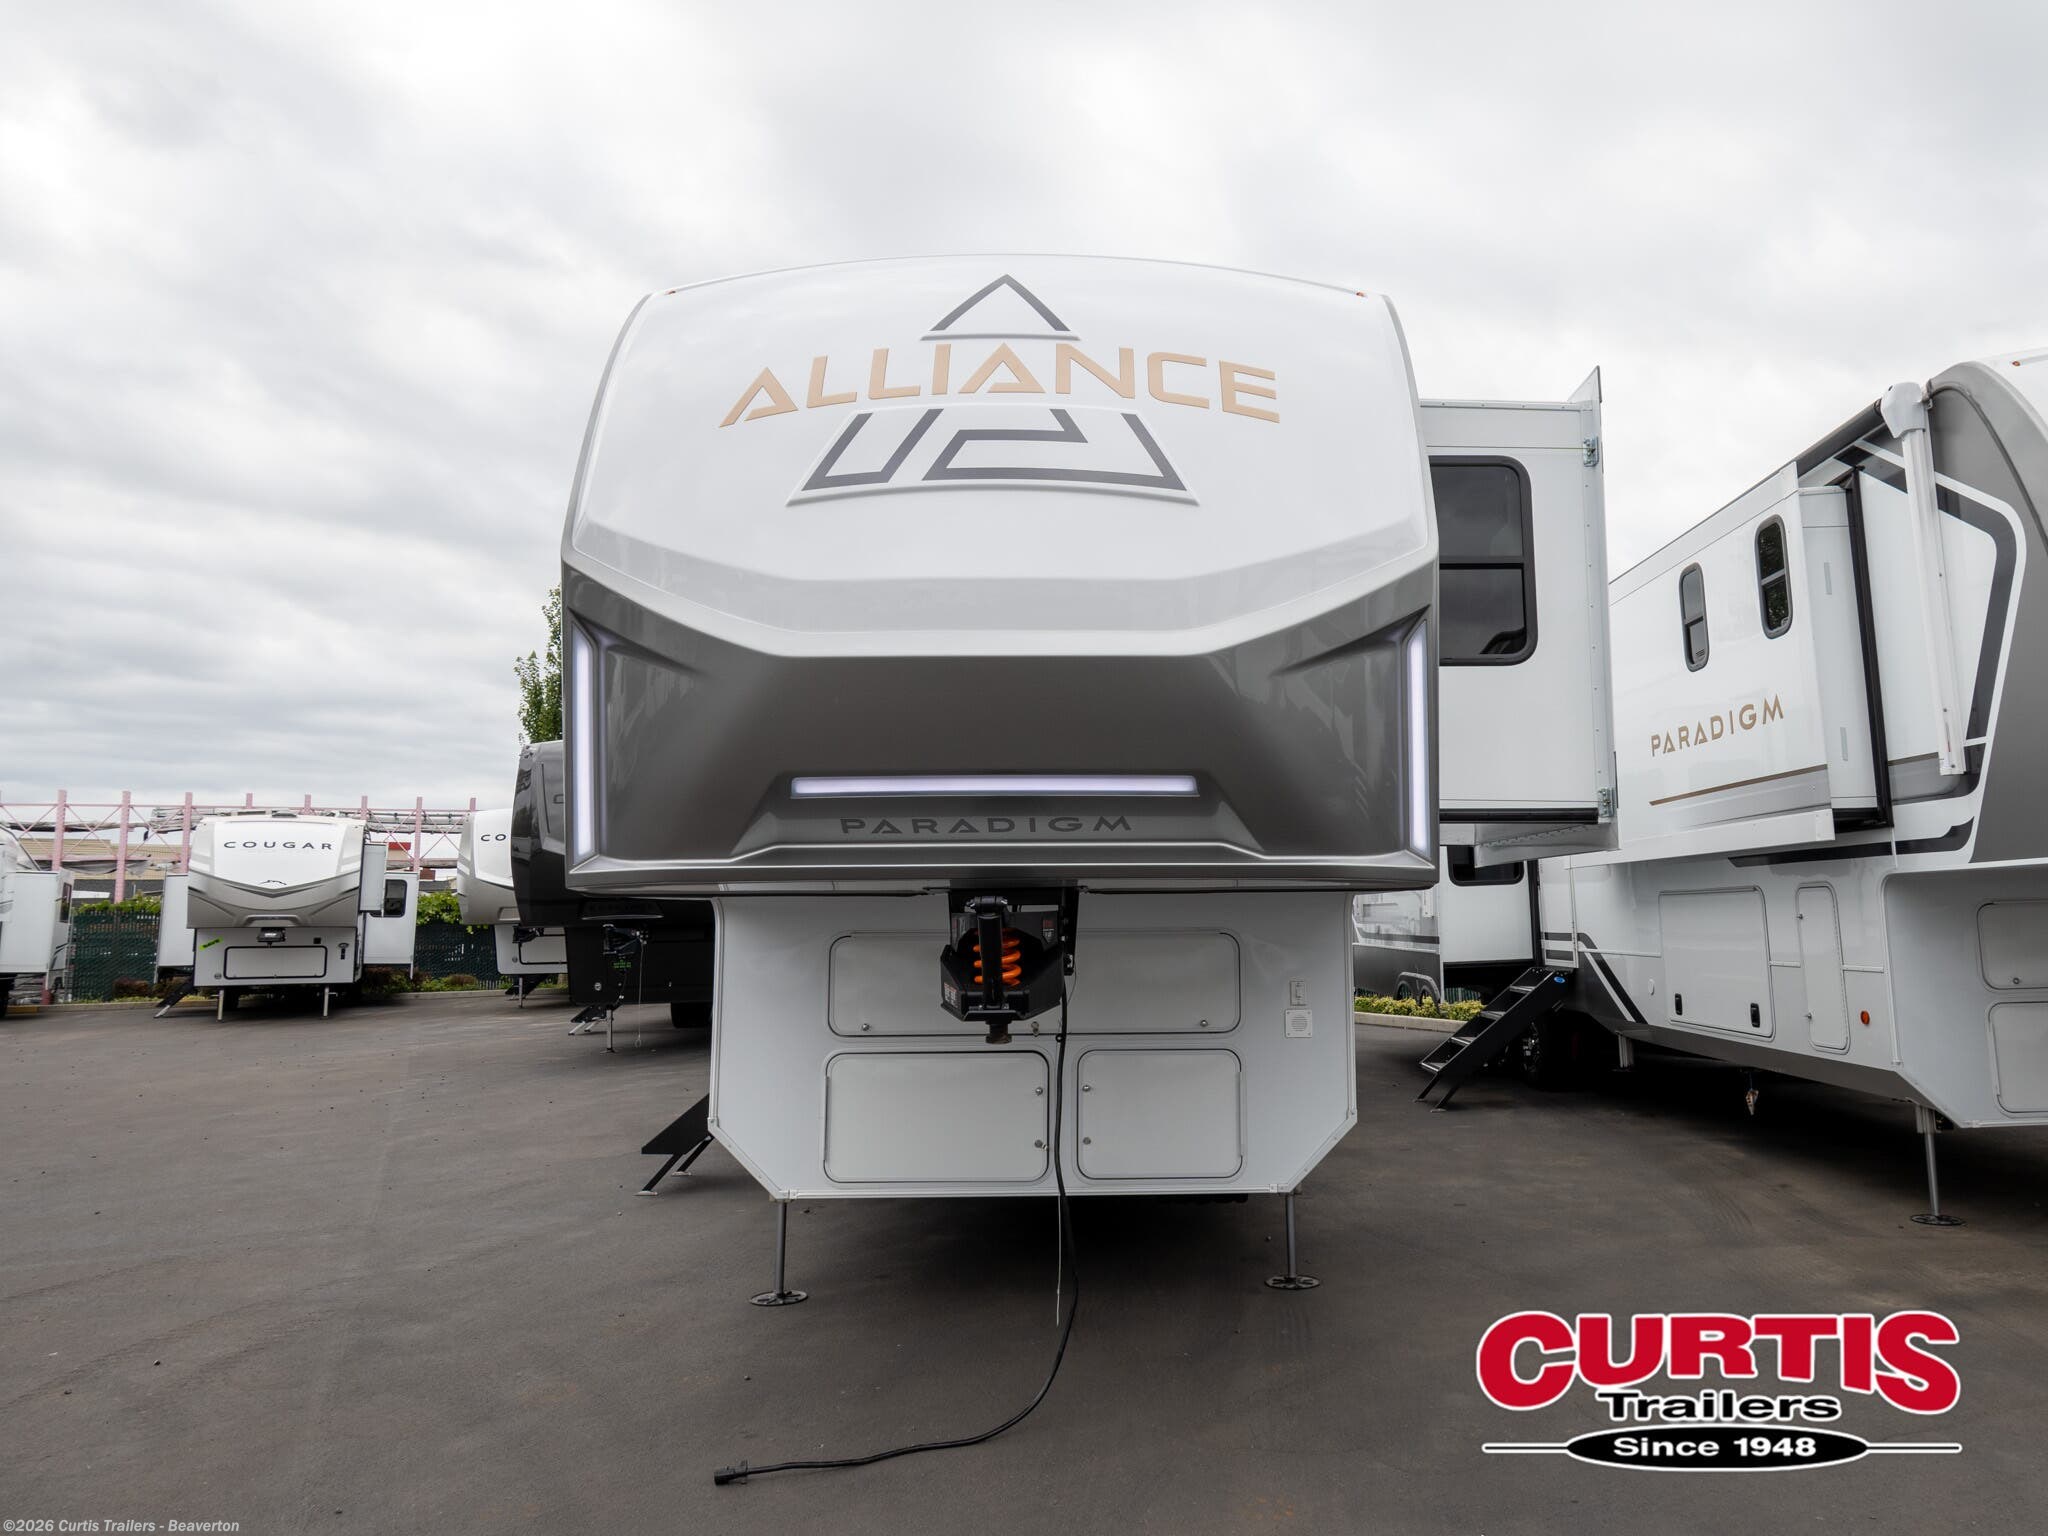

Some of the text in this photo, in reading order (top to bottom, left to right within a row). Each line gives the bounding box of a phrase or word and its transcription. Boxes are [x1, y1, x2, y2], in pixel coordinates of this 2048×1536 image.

[719, 342, 1281, 428] ALLIANCE
[1650, 693, 1785, 758] PARADIGM
[223, 841, 333, 851] COUGAR
[840, 815, 1132, 835] PARADIGM
